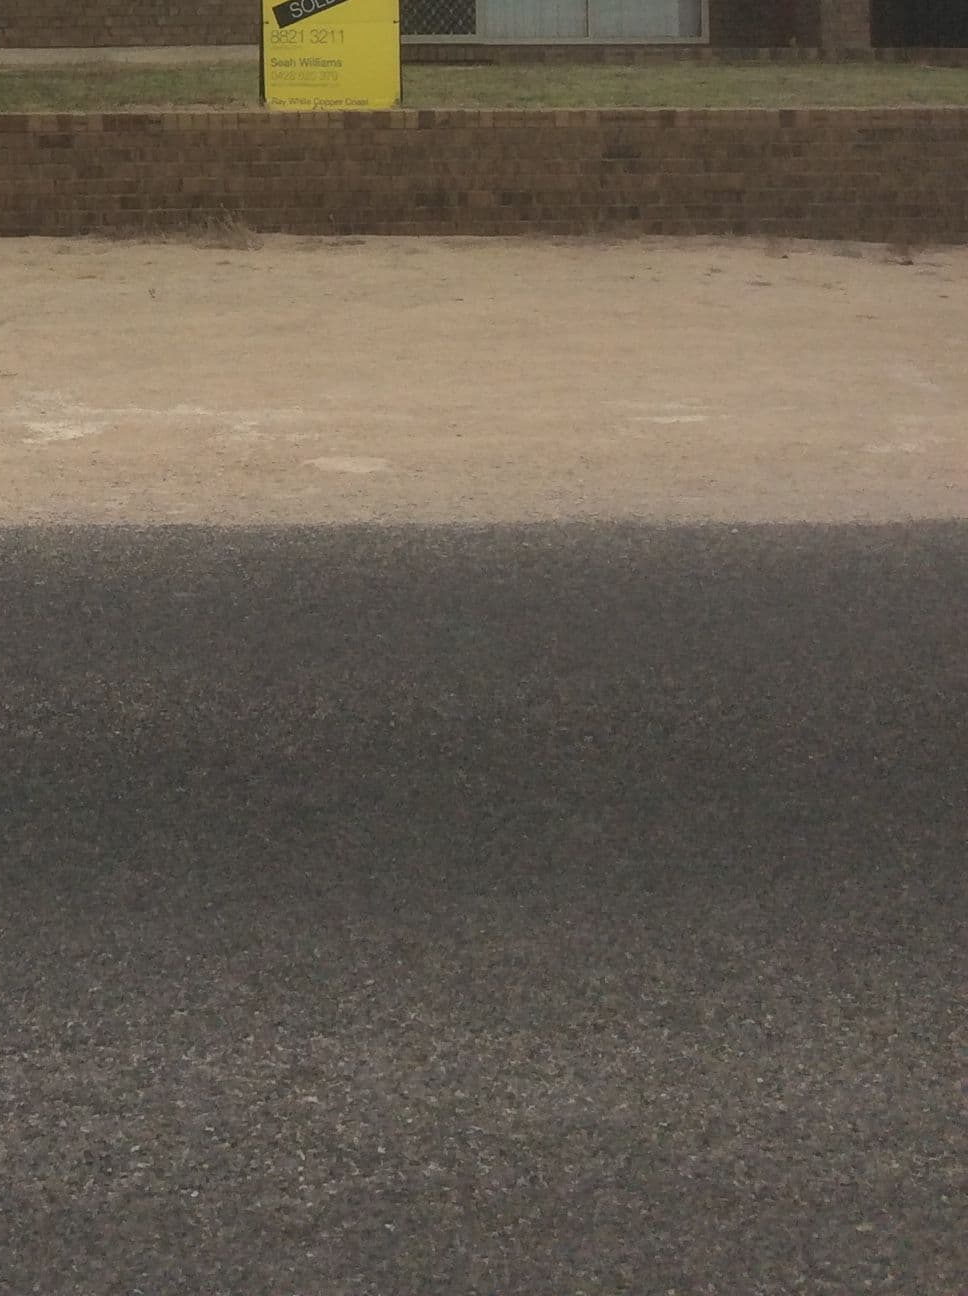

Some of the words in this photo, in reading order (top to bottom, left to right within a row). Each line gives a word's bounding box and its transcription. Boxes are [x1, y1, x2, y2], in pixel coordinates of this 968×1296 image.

[270, 29, 305, 45] 8821
[310, 29, 345, 45] 3211
[299, 57, 343, 68] Williams
[288, 97, 312, 106] White
[313, 97, 343, 107] Copper
